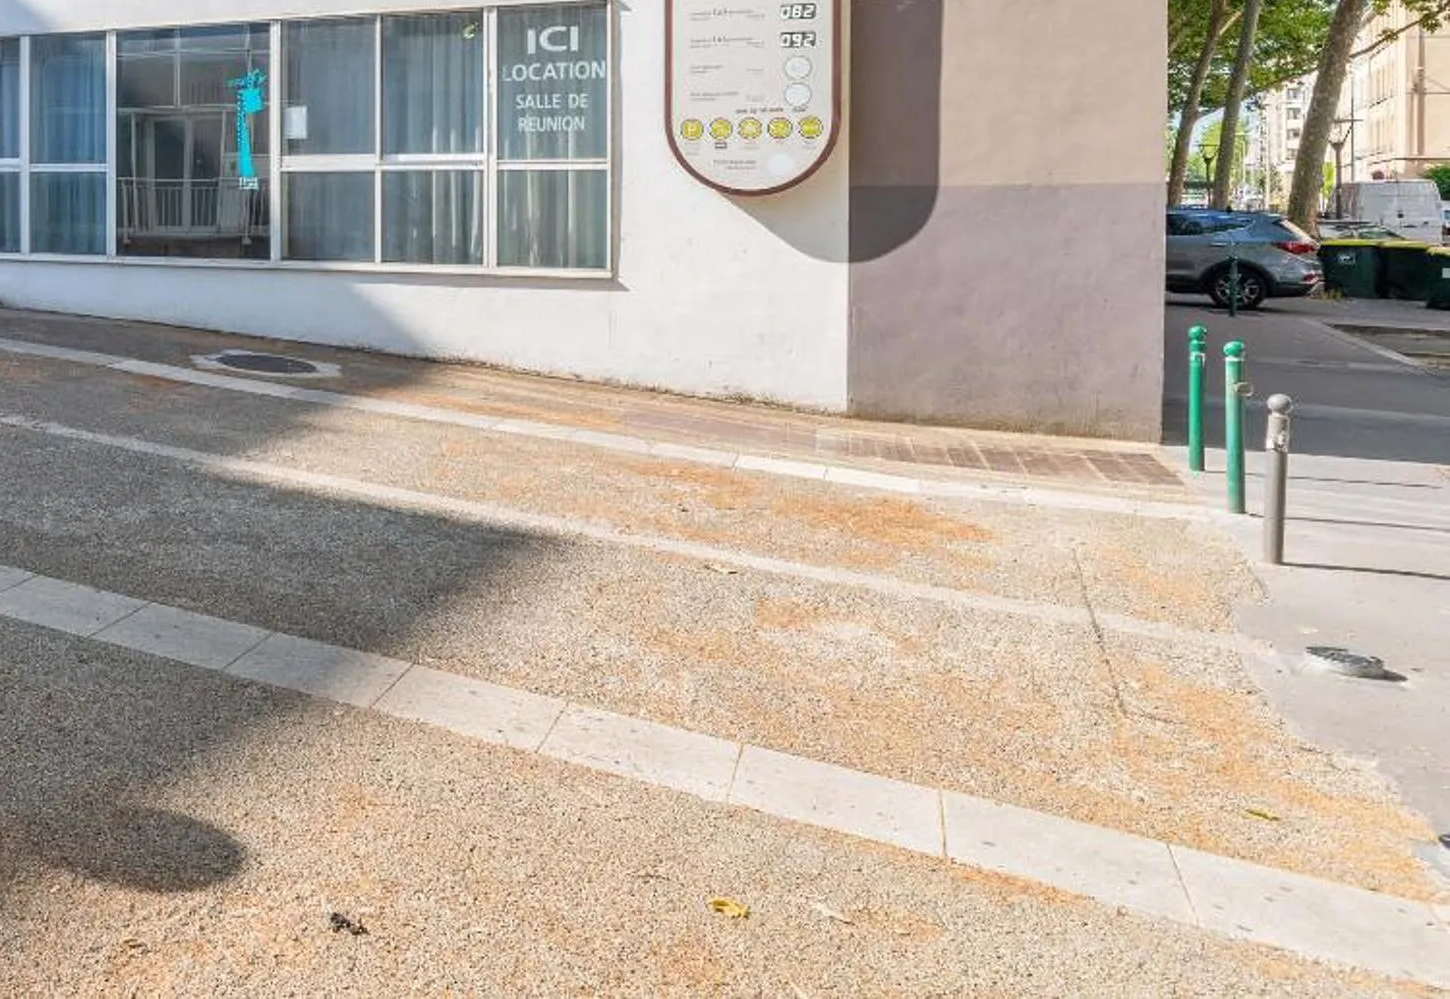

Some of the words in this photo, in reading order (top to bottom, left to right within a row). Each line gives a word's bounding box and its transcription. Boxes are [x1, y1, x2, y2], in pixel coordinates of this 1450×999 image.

[527, 25, 579, 55] ICI
[502, 60, 606, 82] LOCATION
[515, 93, 561, 109] SALLE
[568, 93, 589, 109] DE
